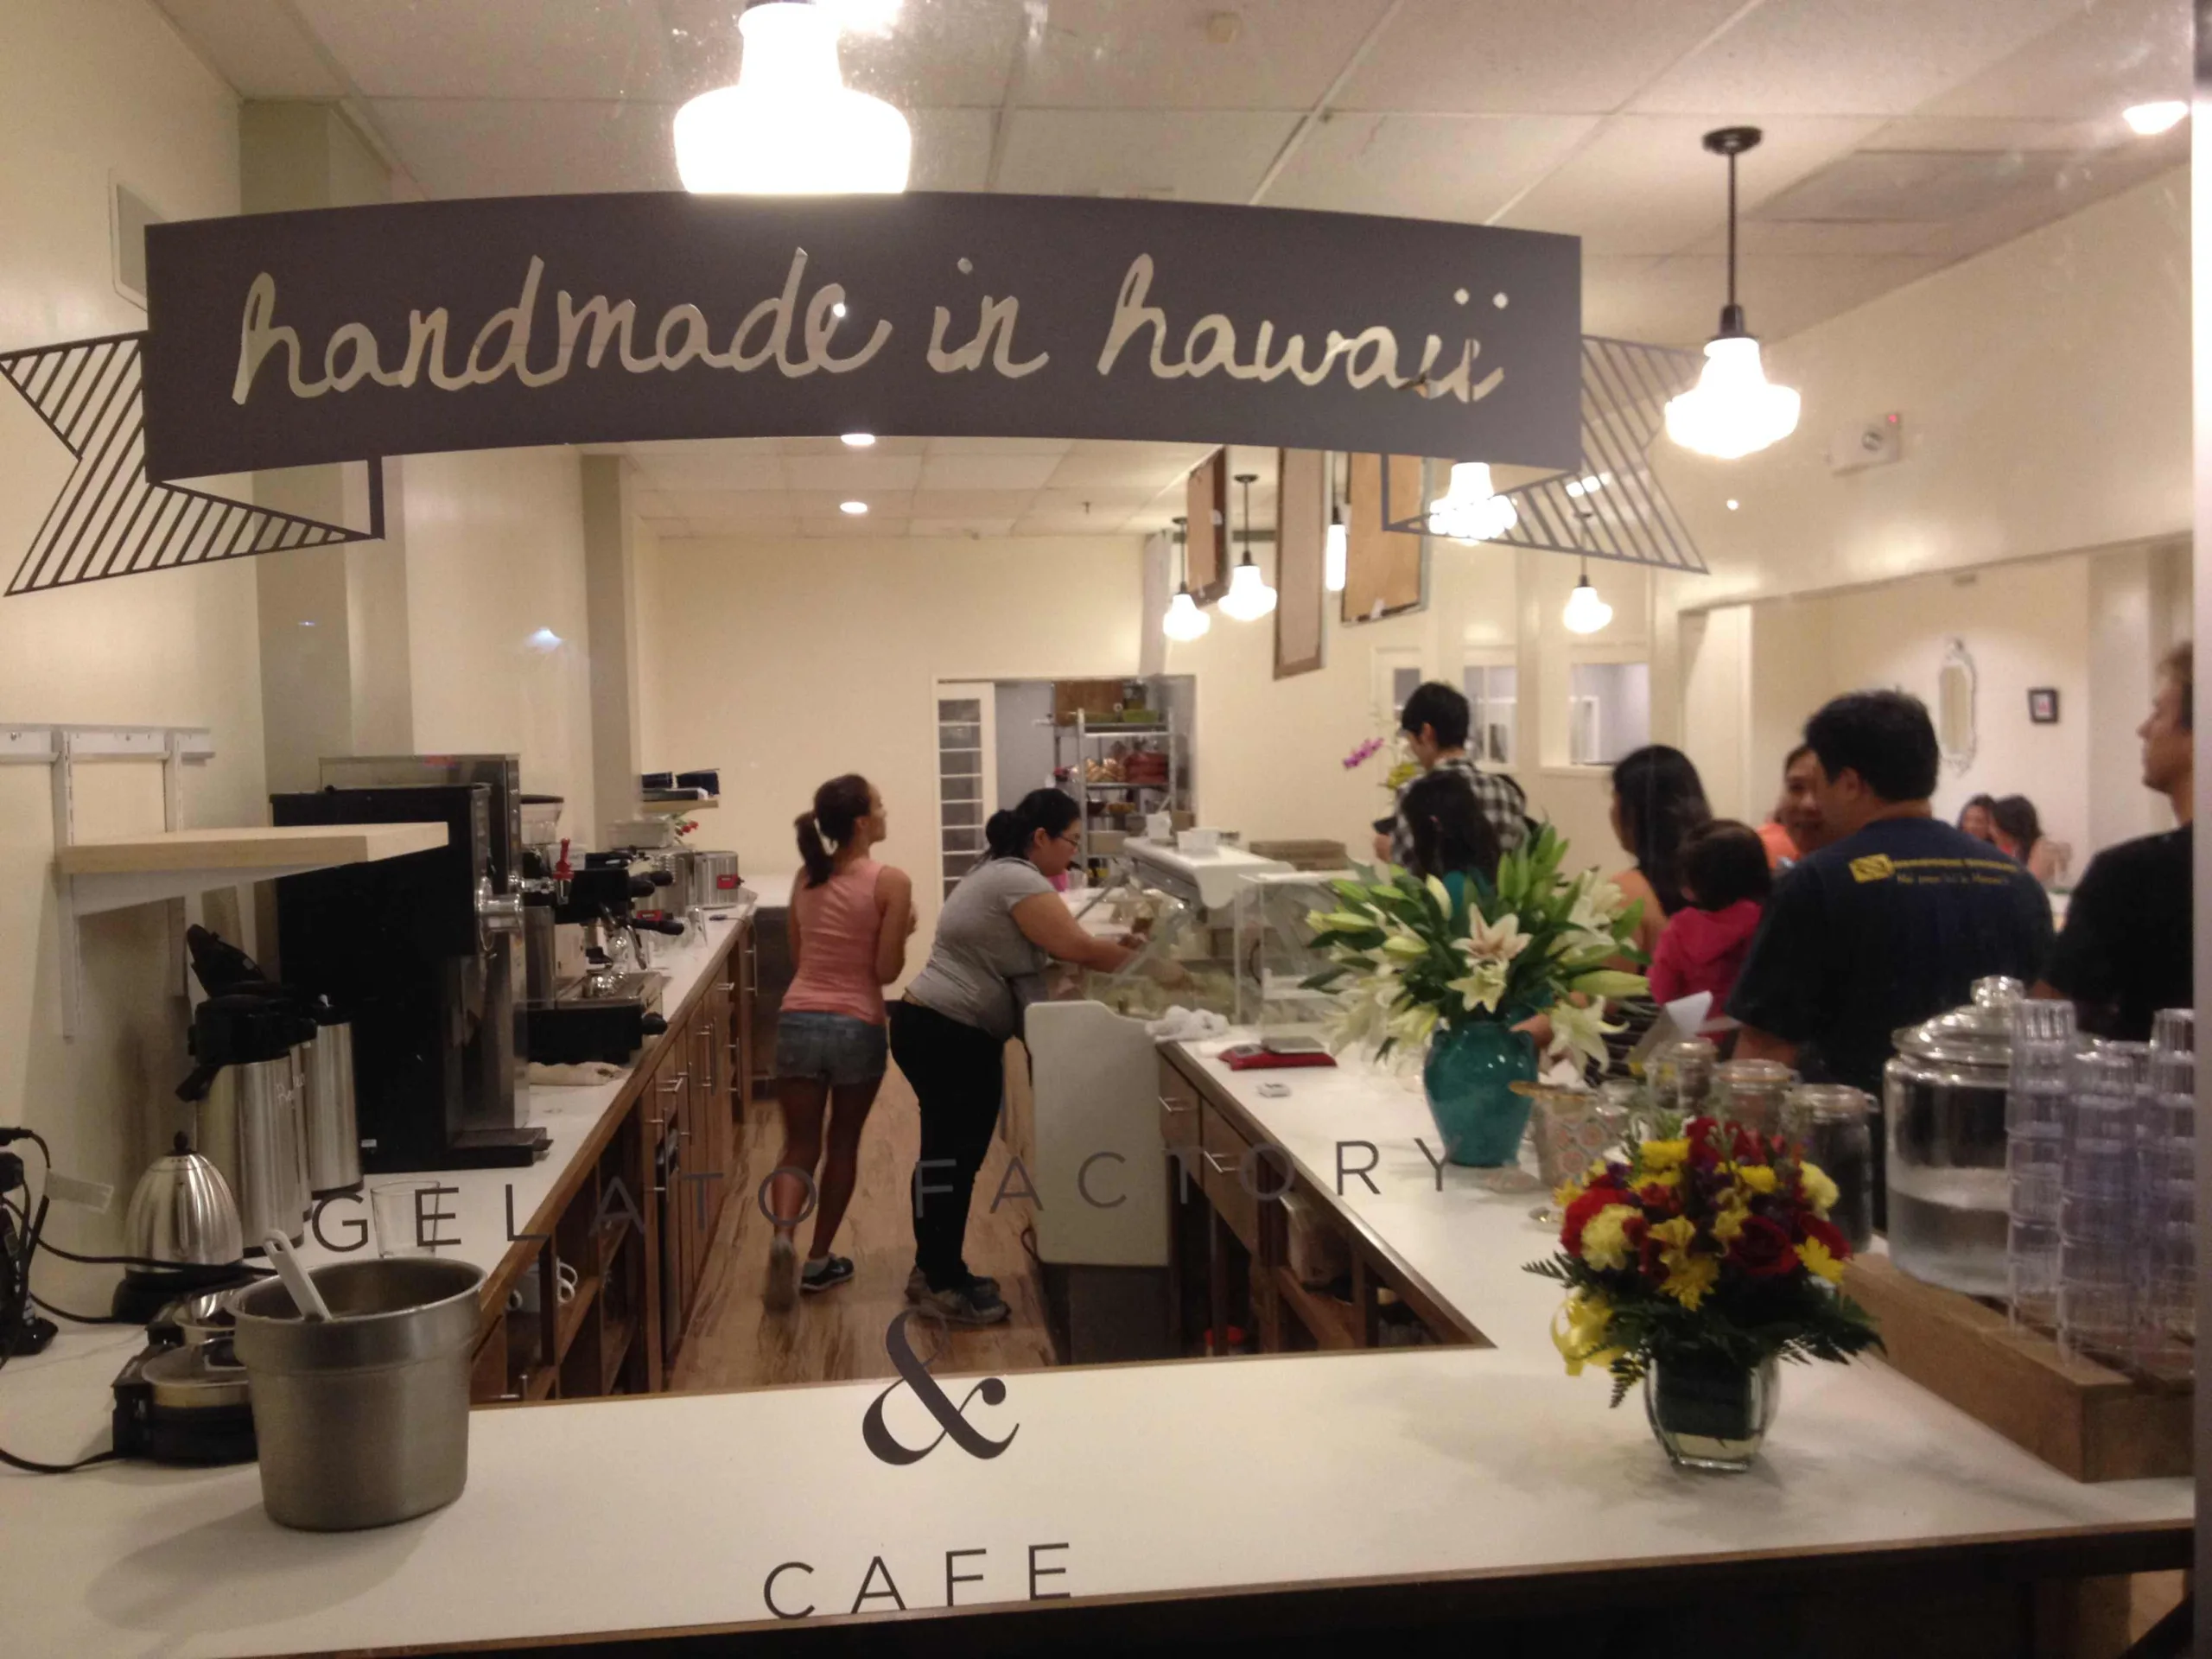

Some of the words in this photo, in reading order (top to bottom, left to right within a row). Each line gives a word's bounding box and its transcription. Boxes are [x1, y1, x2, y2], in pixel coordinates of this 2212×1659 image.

[232, 247, 892, 404] handmade
[926, 257, 1049, 378] in
[1097, 252, 1509, 403] hawaii
[311, 1166, 817, 1252] GELATO
[914, 1135, 1462, 1217] FACTORY
[862, 1307, 1020, 1465] &
[764, 1542, 1071, 1620] CAFE
